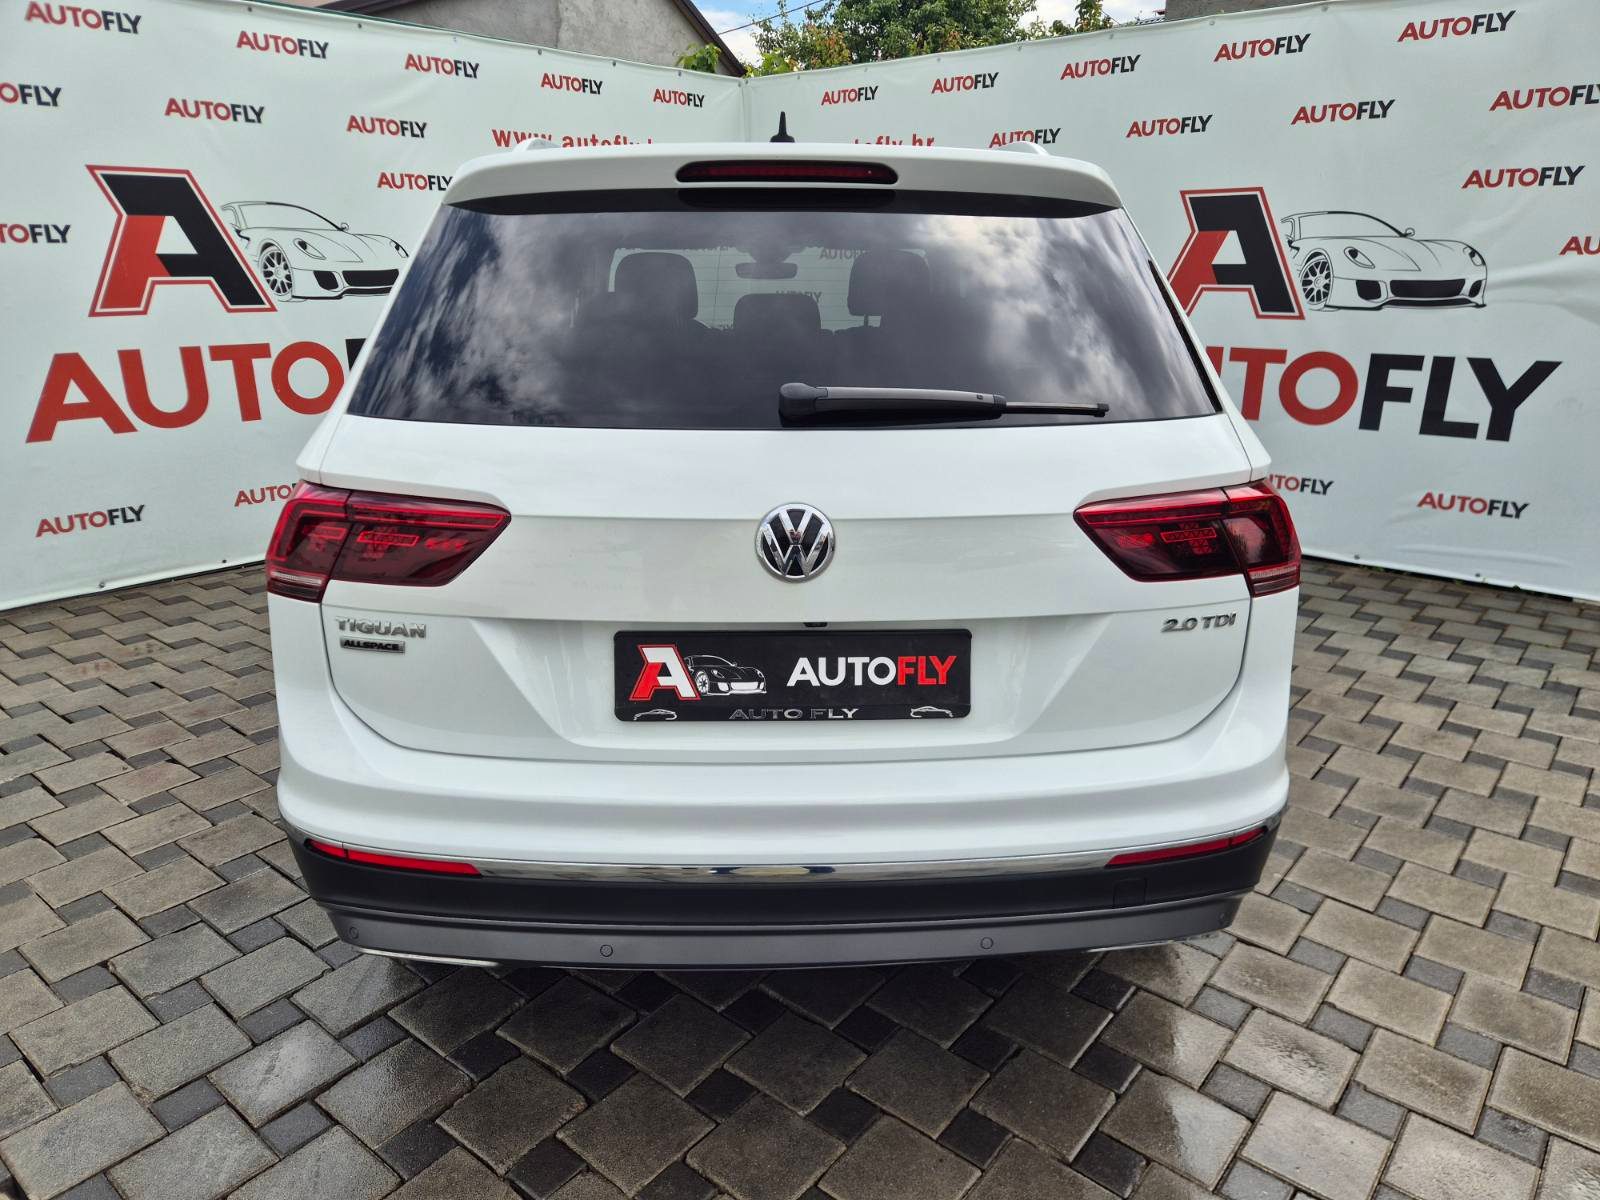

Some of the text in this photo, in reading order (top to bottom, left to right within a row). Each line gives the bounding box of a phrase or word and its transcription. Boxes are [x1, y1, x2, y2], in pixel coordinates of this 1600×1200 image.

[25, 1, 142, 34] AUTOFLY
[1397, 9, 1516, 42] AUTOFLY
[237, 31, 329, 59] AUTOFLY
[1214, 34, 1311, 62] AUTOFLY
[405, 53, 479, 78] AUTOFLY
[1060, 55, 1141, 80] AUTOFLY
[541, 73, 603, 95] AUTOFLY
[931, 72, 999, 94] AUTOFLY
[653, 88, 705, 108] AUTOFLY
[821, 86, 879, 106] AUTOFLY
[1489, 84, 1600, 112] AUTOFL
[164, 98, 265, 123] AUTOFLY
[1291, 99, 1395, 125] AUTOFLY
[346, 115, 427, 138] AUTOFLY
[989, 127, 1061, 148] AUTOFLY
[1126, 115, 1213, 138] AUTOFLY
[1462, 165, 1585, 189] AUTOFLY
[25, 337, 367, 443] AUTO
[234, 483, 297, 507] AUTO
[1417, 491, 1529, 519] AUTOFLY
[36, 505, 145, 537] AUTOFLY
[336, 617, 427, 639] TIGUAN
[1161, 613, 1237, 633] 2.0 TDI
[343, 639, 400, 652] ALLSPACE
[786, 655, 957, 687] AUTOFLY
[729, 708, 859, 720] AUTO FLY
